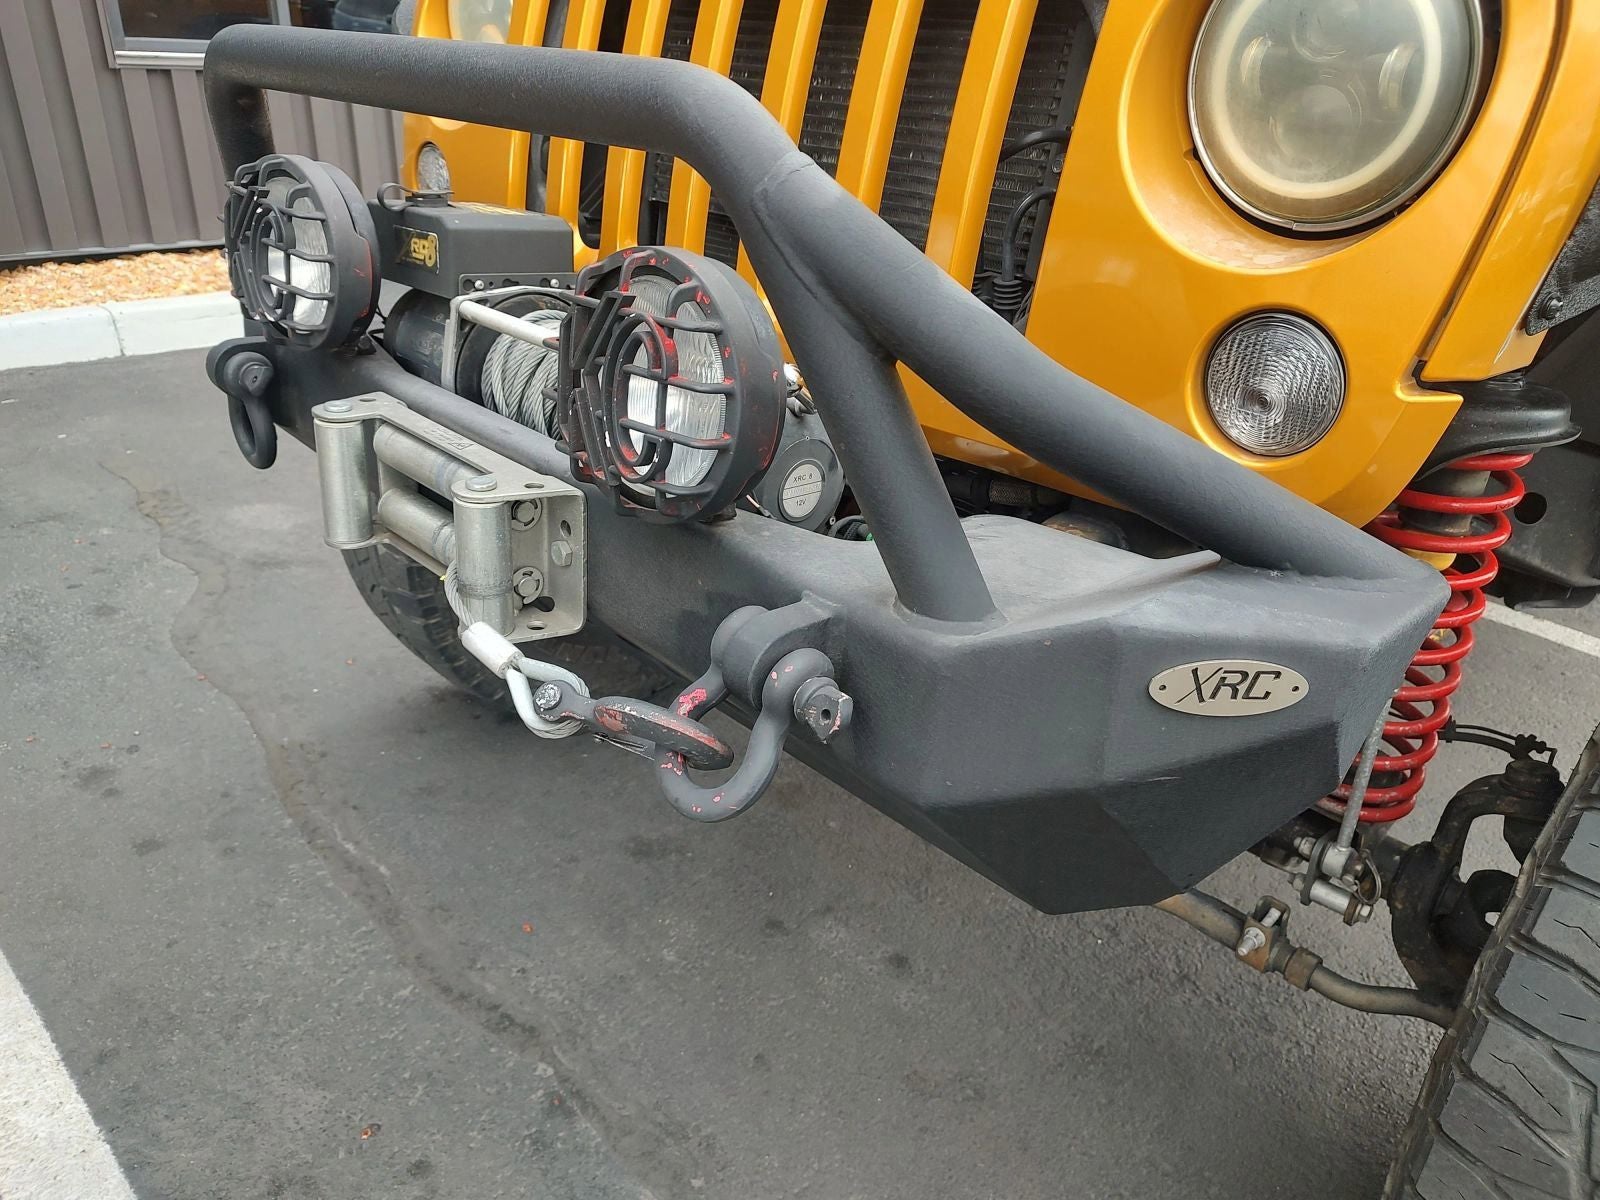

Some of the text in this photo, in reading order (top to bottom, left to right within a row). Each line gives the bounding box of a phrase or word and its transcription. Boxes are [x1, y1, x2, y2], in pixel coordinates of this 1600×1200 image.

[793, 474, 806, 482] XRC
[796, 498, 807, 506] 12V
[1174, 667, 1282, 704] XRC
